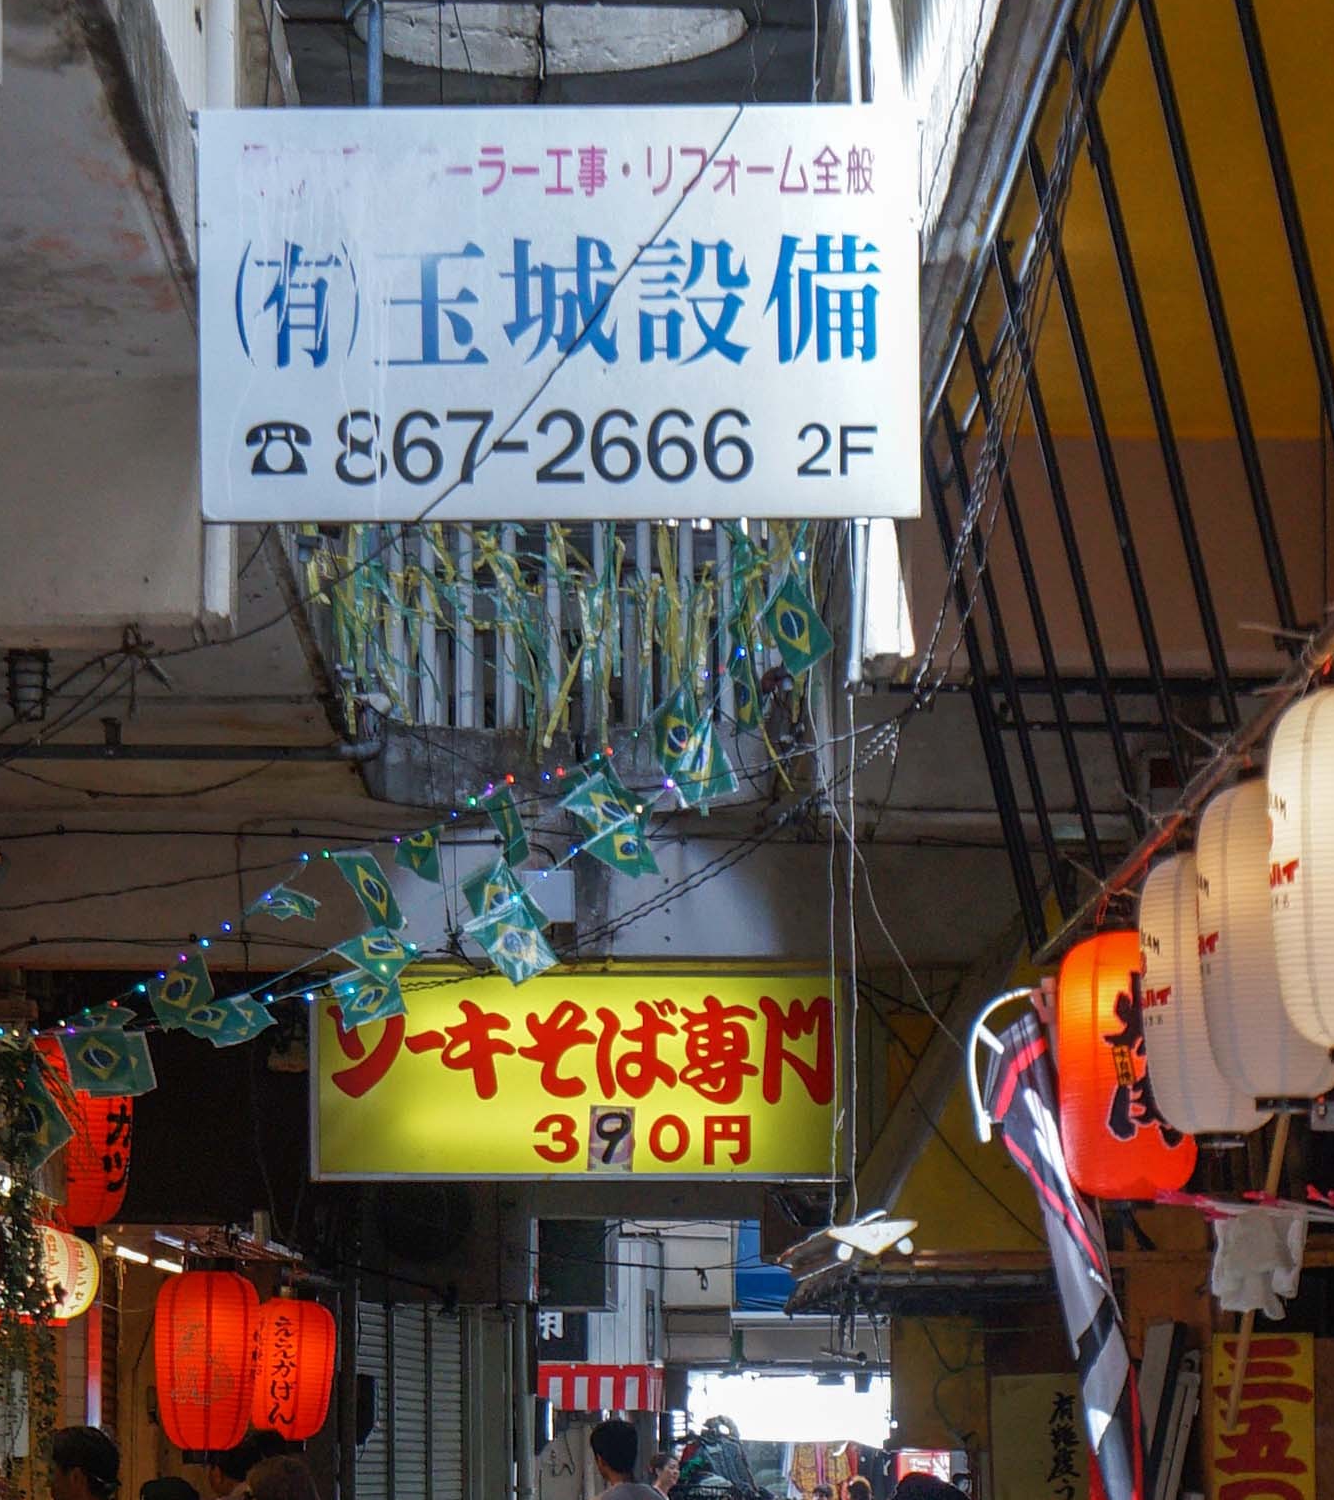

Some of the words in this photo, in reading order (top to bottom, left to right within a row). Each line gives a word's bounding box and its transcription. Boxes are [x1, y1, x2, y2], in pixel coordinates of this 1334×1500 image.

[336, 409, 754, 484] 867-2666
[797, 424, 879, 477] 2F
[327, 994, 836, 1105] ソーキそば専門
[532, 1113, 752, 1166] 390円
[267, 1315, 298, 1426] ええかげん
